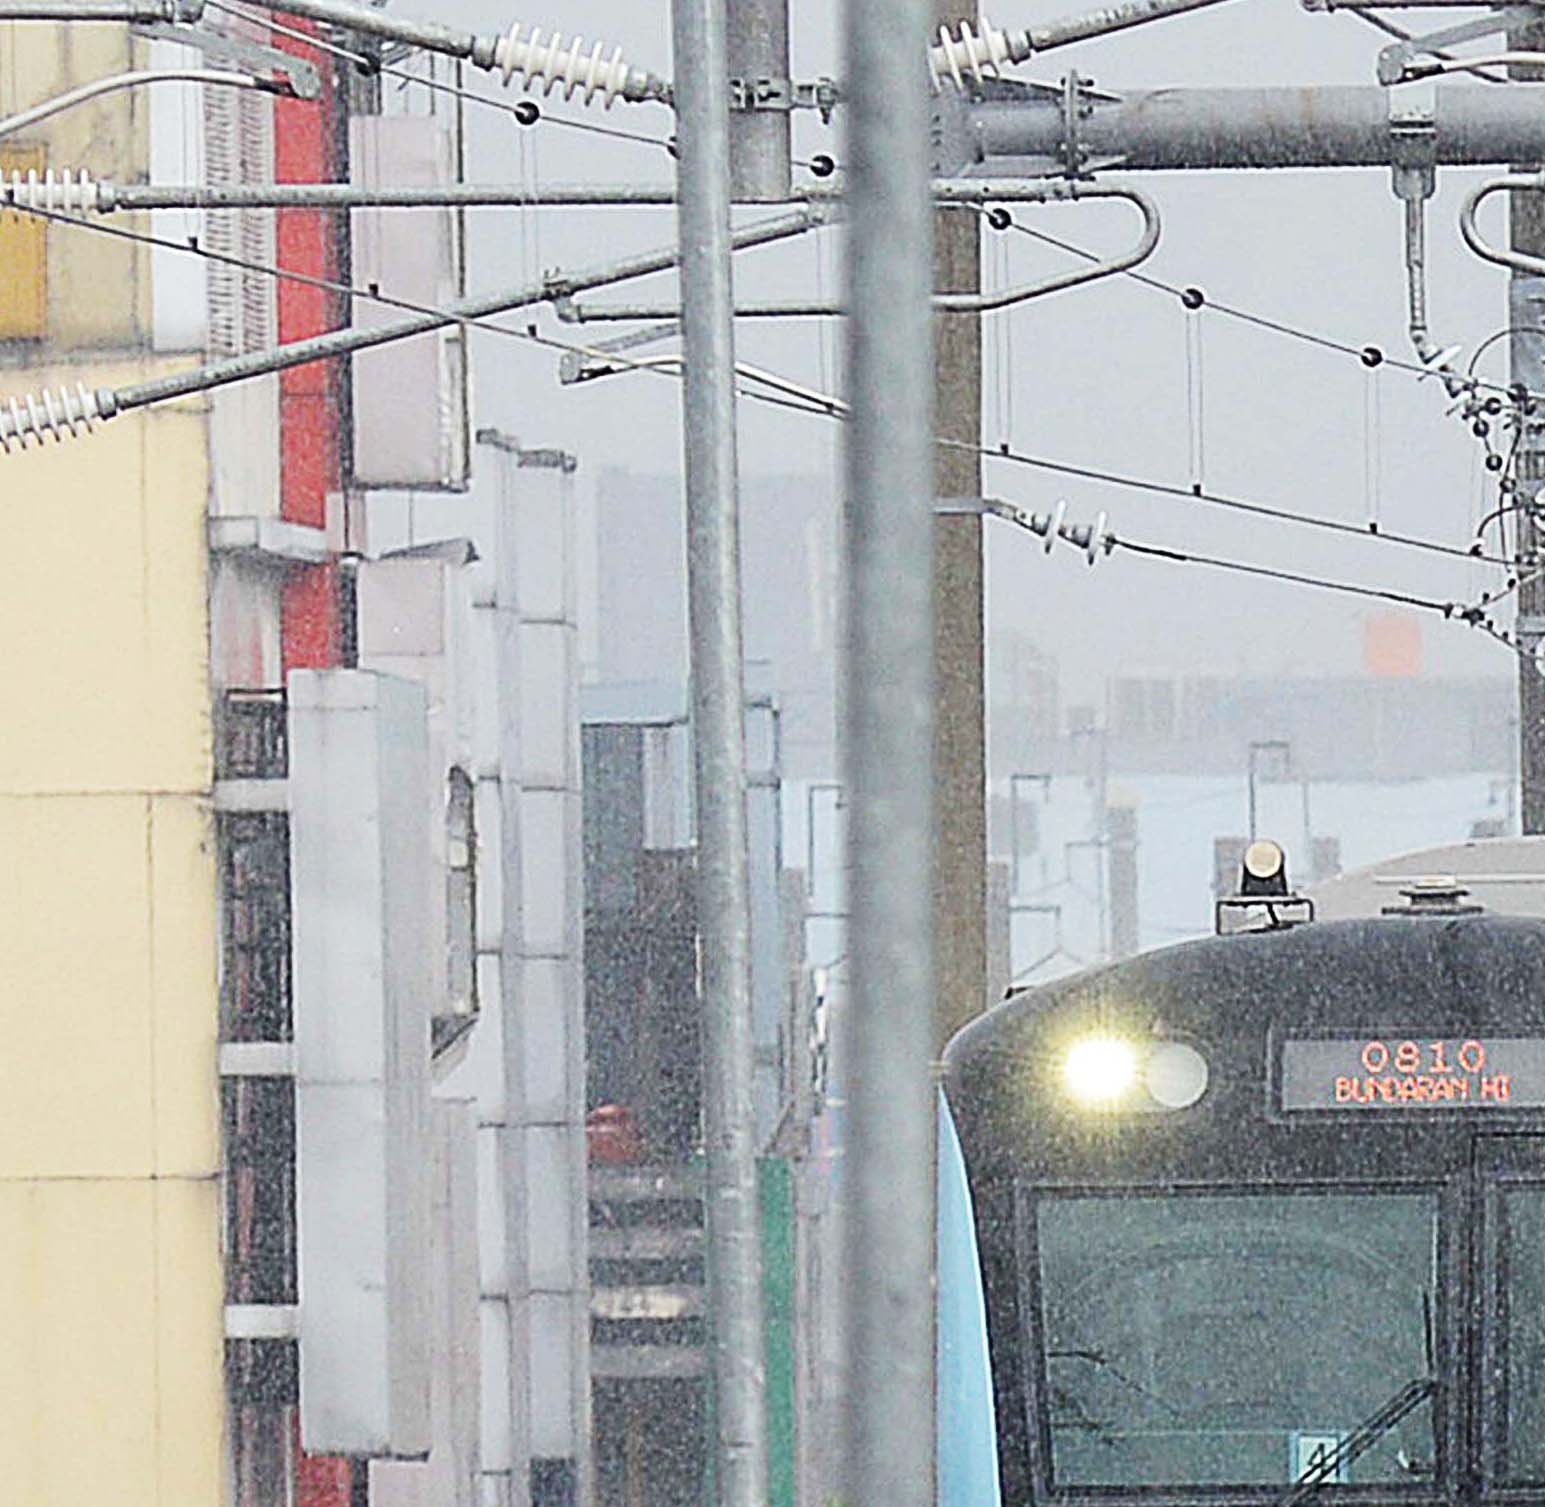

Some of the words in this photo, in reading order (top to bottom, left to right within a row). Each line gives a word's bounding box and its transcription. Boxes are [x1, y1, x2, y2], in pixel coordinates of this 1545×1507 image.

[1361, 1040, 1486, 1073] 0810
[1335, 1076, 1470, 1103] BUNDARAN
[1481, 1075, 1511, 1102] HI
